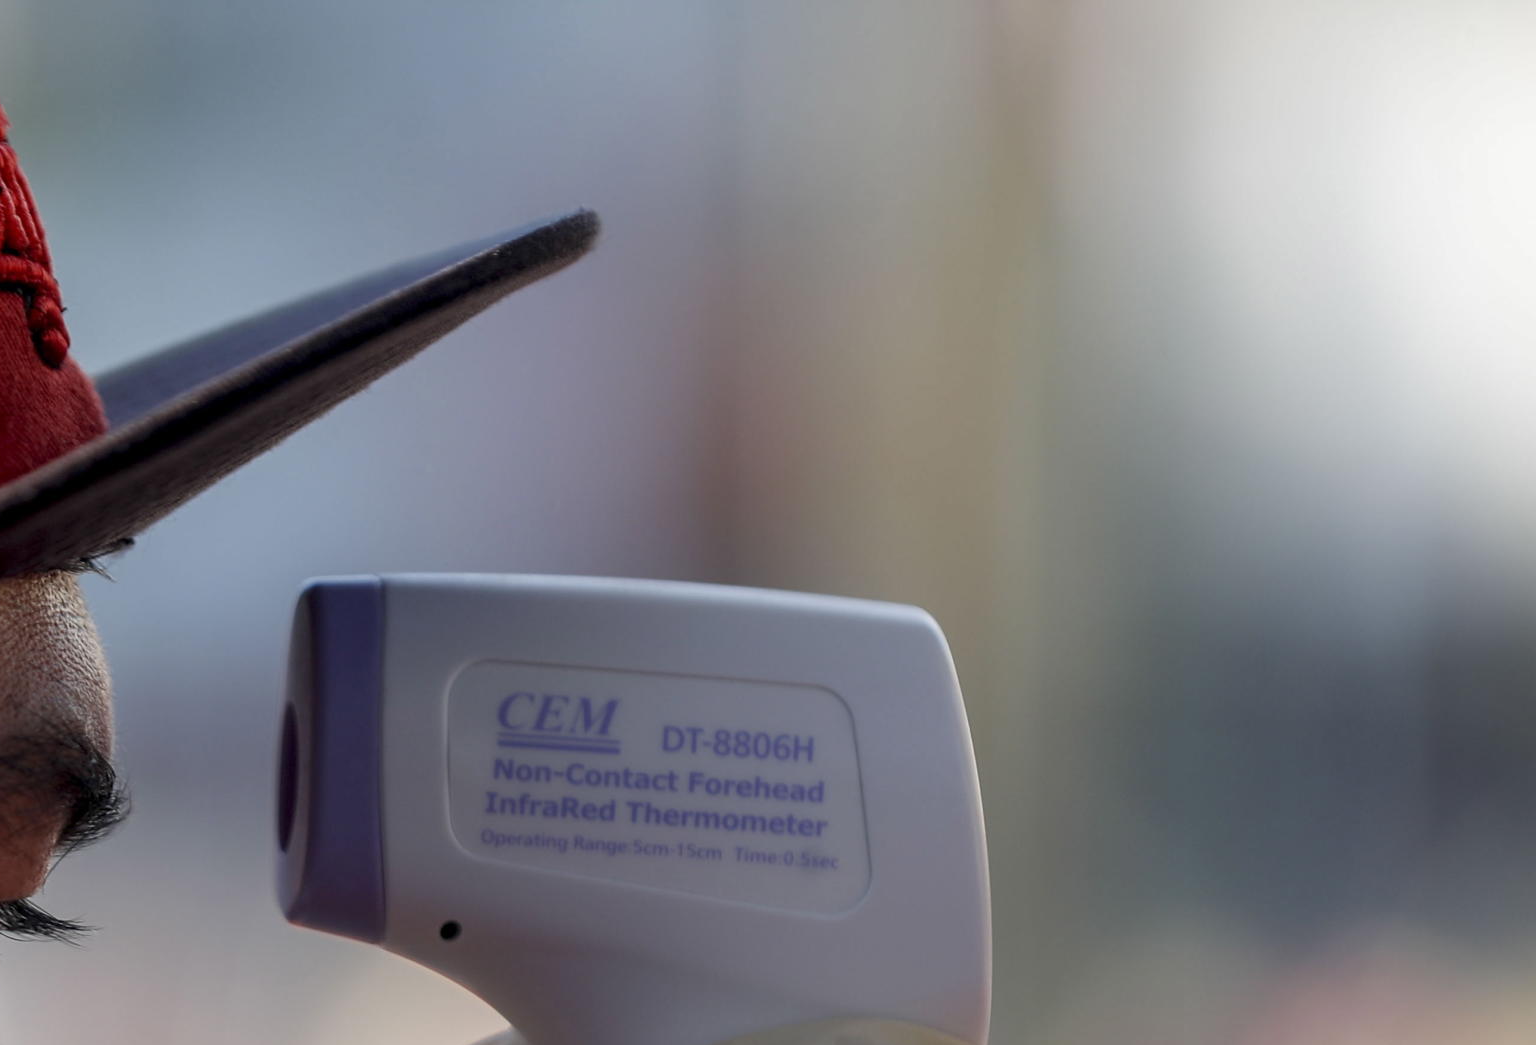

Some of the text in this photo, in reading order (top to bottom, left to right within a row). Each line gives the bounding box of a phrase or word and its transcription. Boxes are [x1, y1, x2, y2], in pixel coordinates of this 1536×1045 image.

[496, 691, 620, 737] CEM
[662, 725, 815, 763] DT-8806H
[493, 758, 826, 803] Non-Contact Forehead
[484, 791, 828, 837] InfraRed Thermometer
[480, 829, 569, 854] Operating
